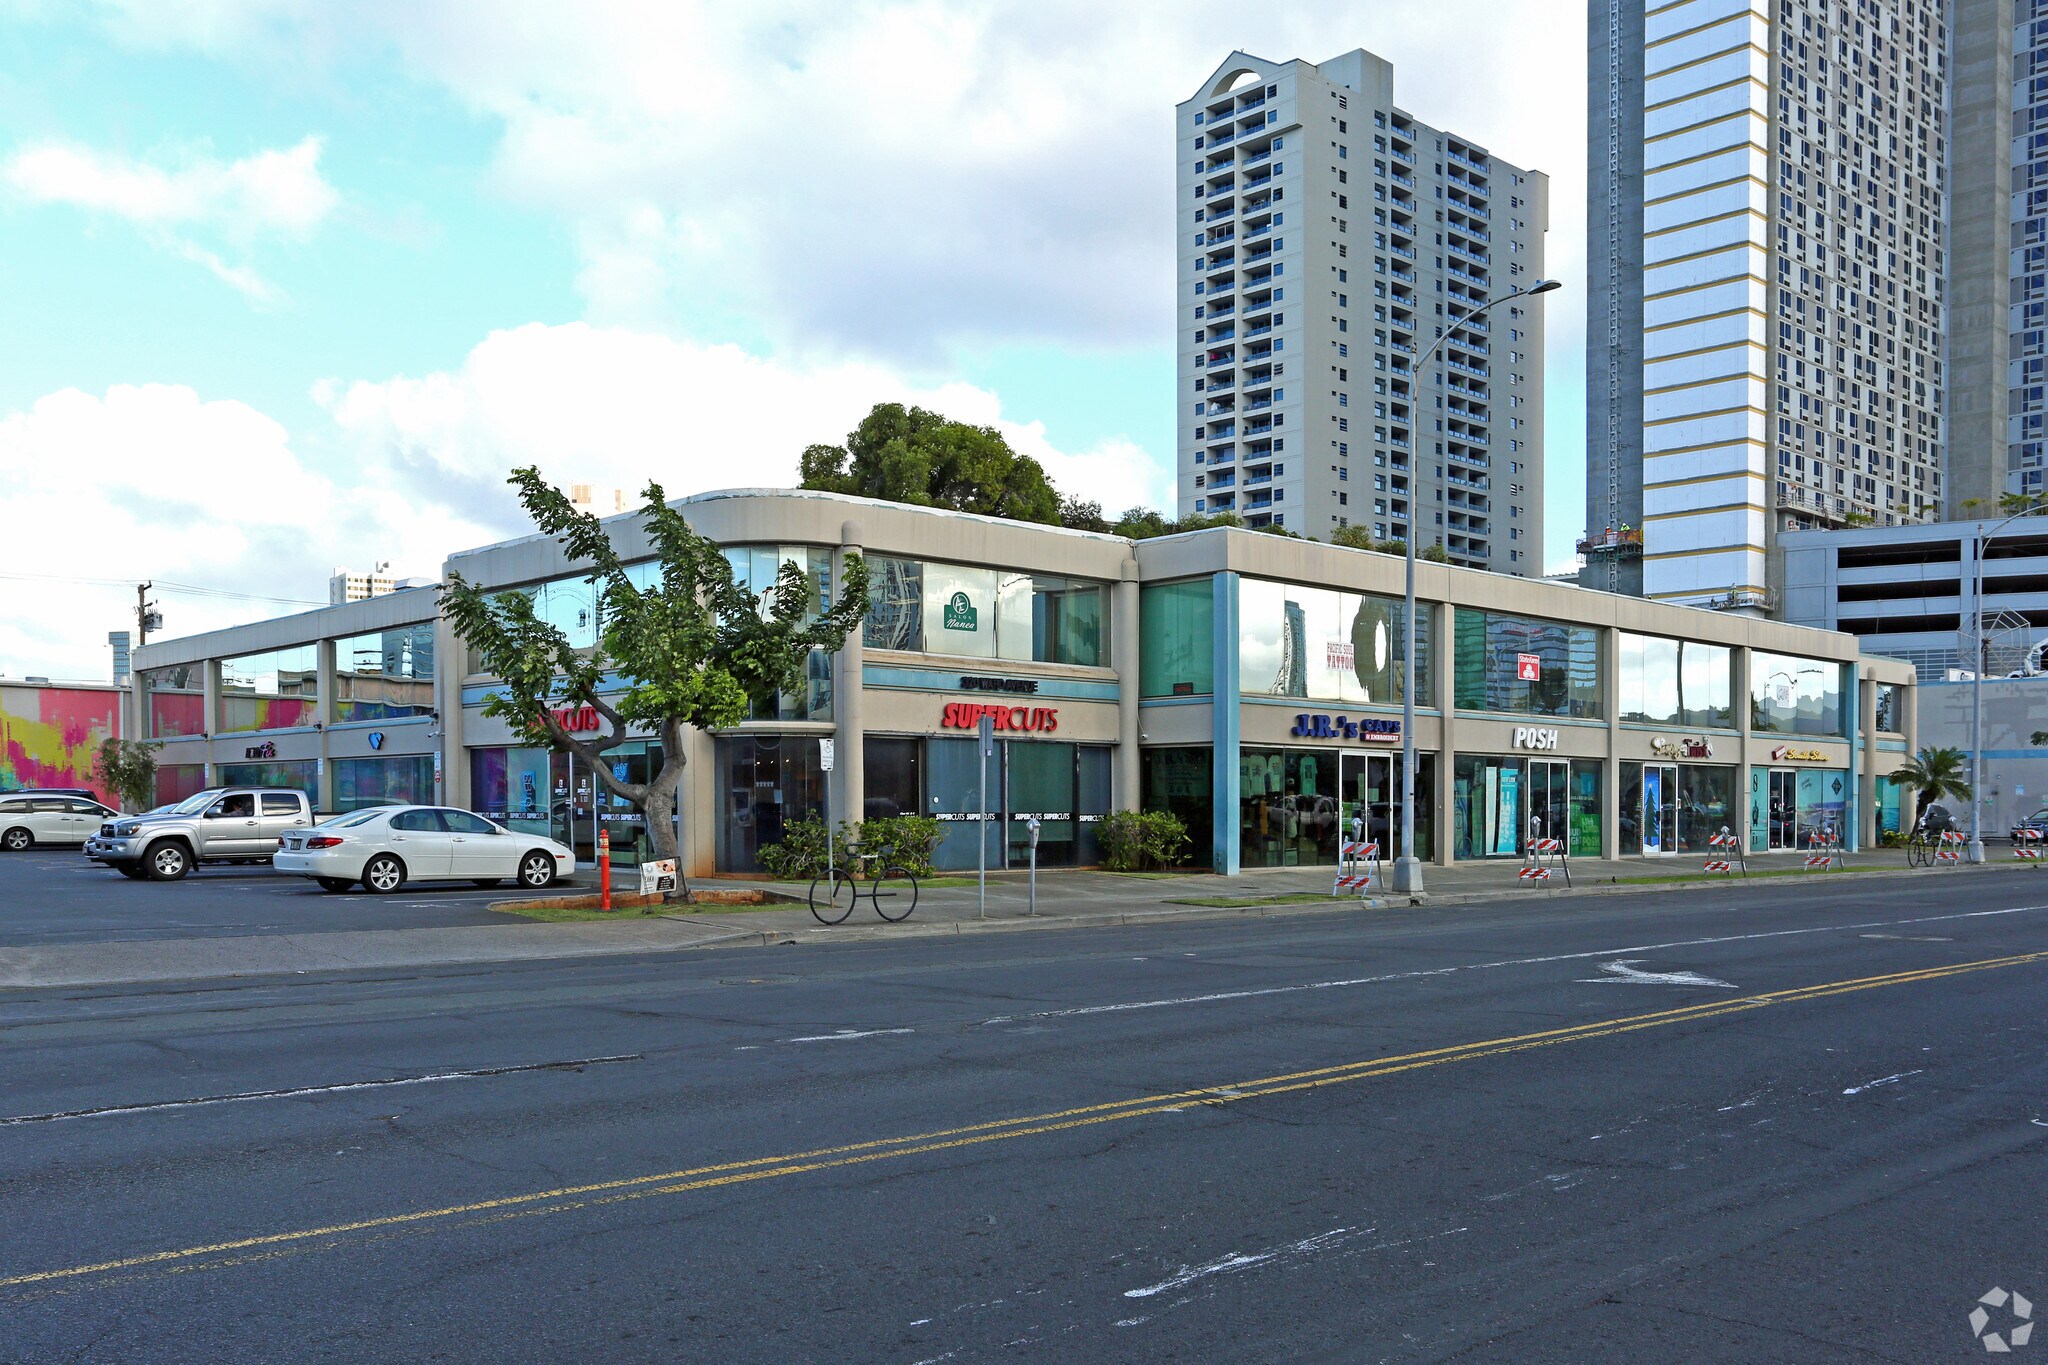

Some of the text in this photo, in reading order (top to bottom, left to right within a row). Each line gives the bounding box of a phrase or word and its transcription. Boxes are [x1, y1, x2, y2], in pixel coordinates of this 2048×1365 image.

[1327, 655, 1354, 670] TATTOO
[978, 678, 1004, 691] WARD
[1004, 679, 1038, 693] AVENUE
[942, 702, 1059, 732] SUPERCUTS
[1291, 713, 1401, 739] J.R.'s CAPS
[1512, 727, 1559, 750] POSH
[936, 813, 996, 821] SUPERCUTS SUPECUTS
[1015, 813, 1071, 821] SUPERCUTS SUPERCUTS
